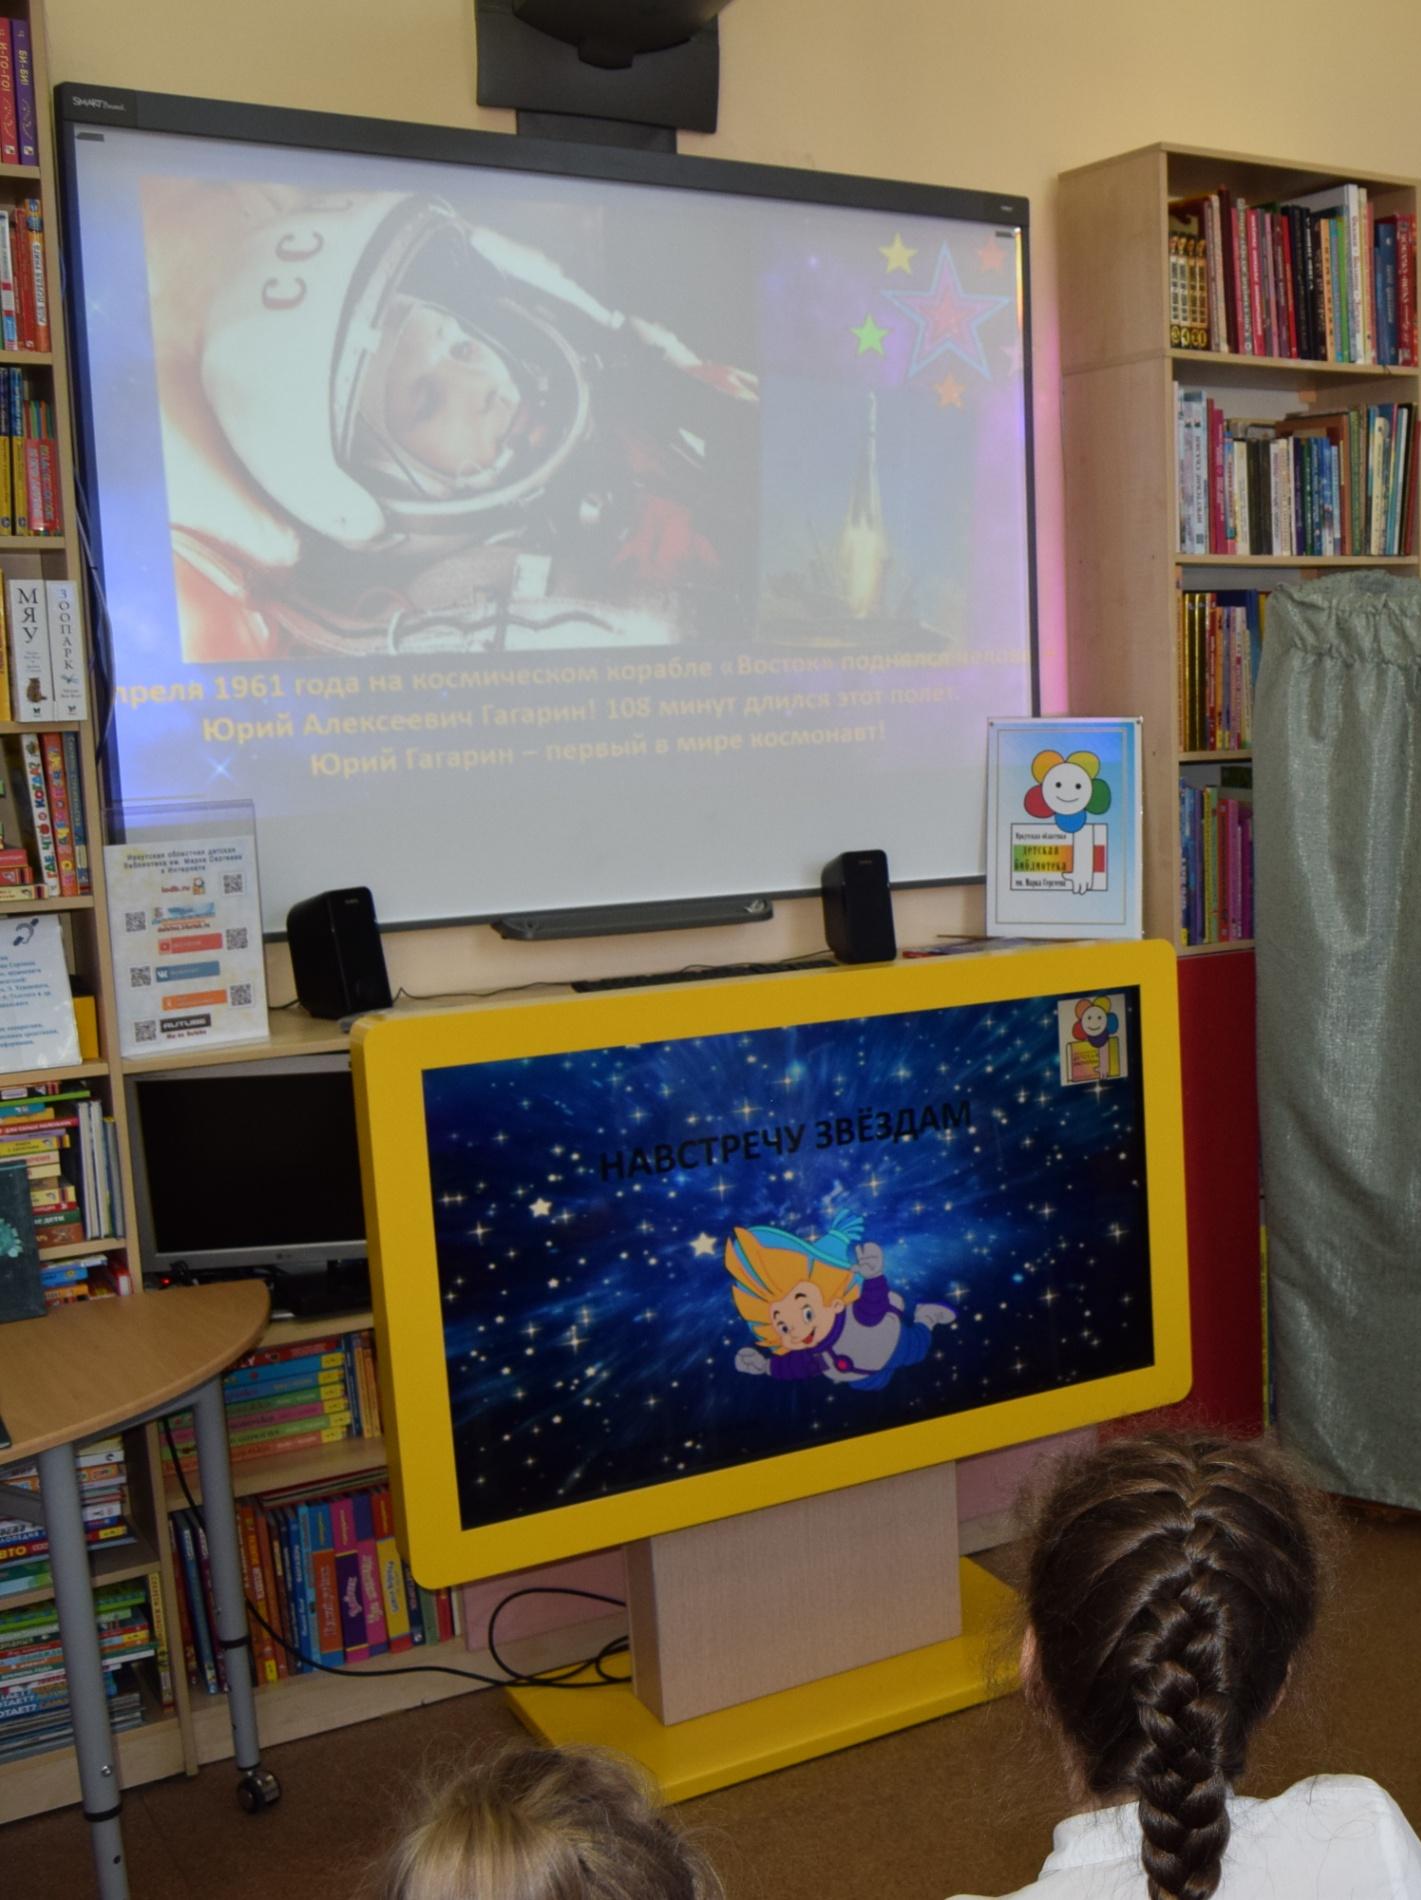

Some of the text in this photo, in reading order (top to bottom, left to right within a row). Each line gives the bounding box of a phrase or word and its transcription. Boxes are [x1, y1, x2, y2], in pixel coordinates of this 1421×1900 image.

[72, 96, 103, 108] SMART
[18, 587, 39, 644] МЯУ
[57, 588, 74, 670] ЗООПАРК
[214, 674, 286, 701] 1961
[295, 672, 360, 699] года
[368, 671, 403, 692] на
[412, 663, 598, 690] космическом
[606, 656, 713, 683] корабле
[202, 712, 295, 744] Юрий
[303, 704, 474, 738] Алексеевич
[482, 698, 596, 729] Гагарин!
[606, 697, 652, 721] 108
[659, 694, 739, 719] минут
[744, 689, 831, 714] длился
[838, 689, 882, 708] этот
[310, 749, 397, 779] Юрий
[407, 741, 514, 772] Гагарин
[546, 731, 648, 764] первый
[655, 737, 670, 754] в
[677, 730, 742, 756] мире
[750, 720, 887, 746] космонавт!
[29, 762, 45, 808] КОГДА?
[599, 1099, 974, 1182] НАВСТРЕЧУ ЗВЁЗДАМ
